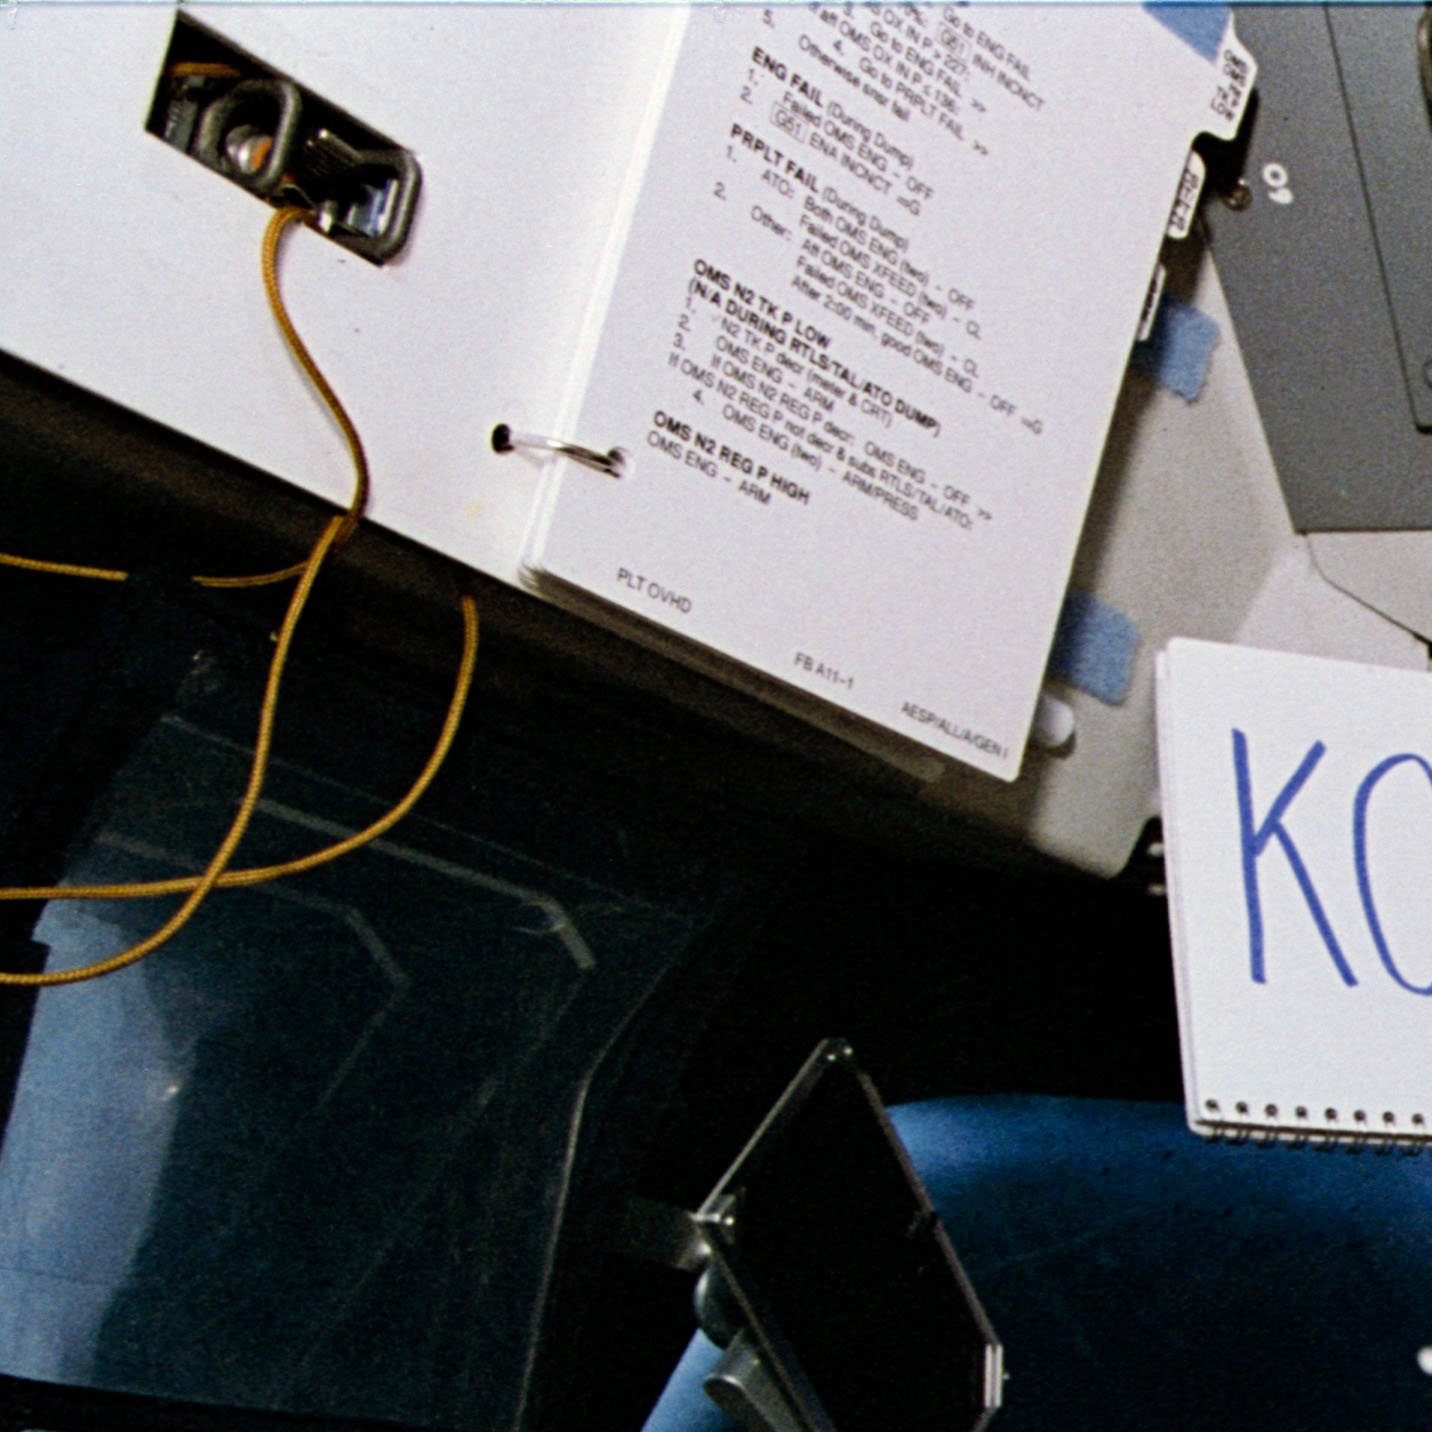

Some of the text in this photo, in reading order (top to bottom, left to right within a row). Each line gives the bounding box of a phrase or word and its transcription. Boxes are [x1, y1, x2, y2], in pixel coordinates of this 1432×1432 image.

[751, 46, 786, 81] ENG
[789, 73, 822, 107] FAIL
[730, 123, 783, 165] PRPLT
[785, 159, 818, 193] FAIL
[739, 84, 753, 105] 2.
[808, 131, 837, 158] ENA
[782, 91, 822, 128] Failed
[825, 120, 854, 150] OMS
[857, 142, 886, 172] ENG
[905, 175, 934, 200] OFF
[725, 144, 737, 163] 1.
[835, 216, 865, 245] OMS
[868, 237, 897, 265] ENG
[947, 287, 974, 310] OFF
[694, 258, 830, 349] OMS N2 TK P LOW
[677, 313, 834, 412] 2. OMS ENG ARM
[725, 298, 786, 345] DURING
[894, 398, 939, 436] DUMP)
[763, 341, 775, 354] P
[672, 331, 686, 351] 3.
[722, 360, 755, 389] OMS
[757, 380, 778, 401] N2
[778, 392, 810, 420] REG
[810, 410, 823, 423] P
[864, 440, 895, 467] OMS
[896, 458, 925, 484] ENG
[943, 484, 970, 505] OFF
[680, 358, 715, 388] OMS
[715, 378, 737, 406] N2
[738, 390, 770, 420] REG
[771, 409, 784, 423] P
[691, 389, 703, 404] 4.
[722, 403, 756, 432] OMS
[757, 423, 789, 451] ENG
[646, 430, 771, 505] OMS ENG ARM
[653, 410, 810, 504] OMS N2 REG P HIGH
[616, 567, 692, 614] PLT OVHD
[793, 651, 814, 672] FB
